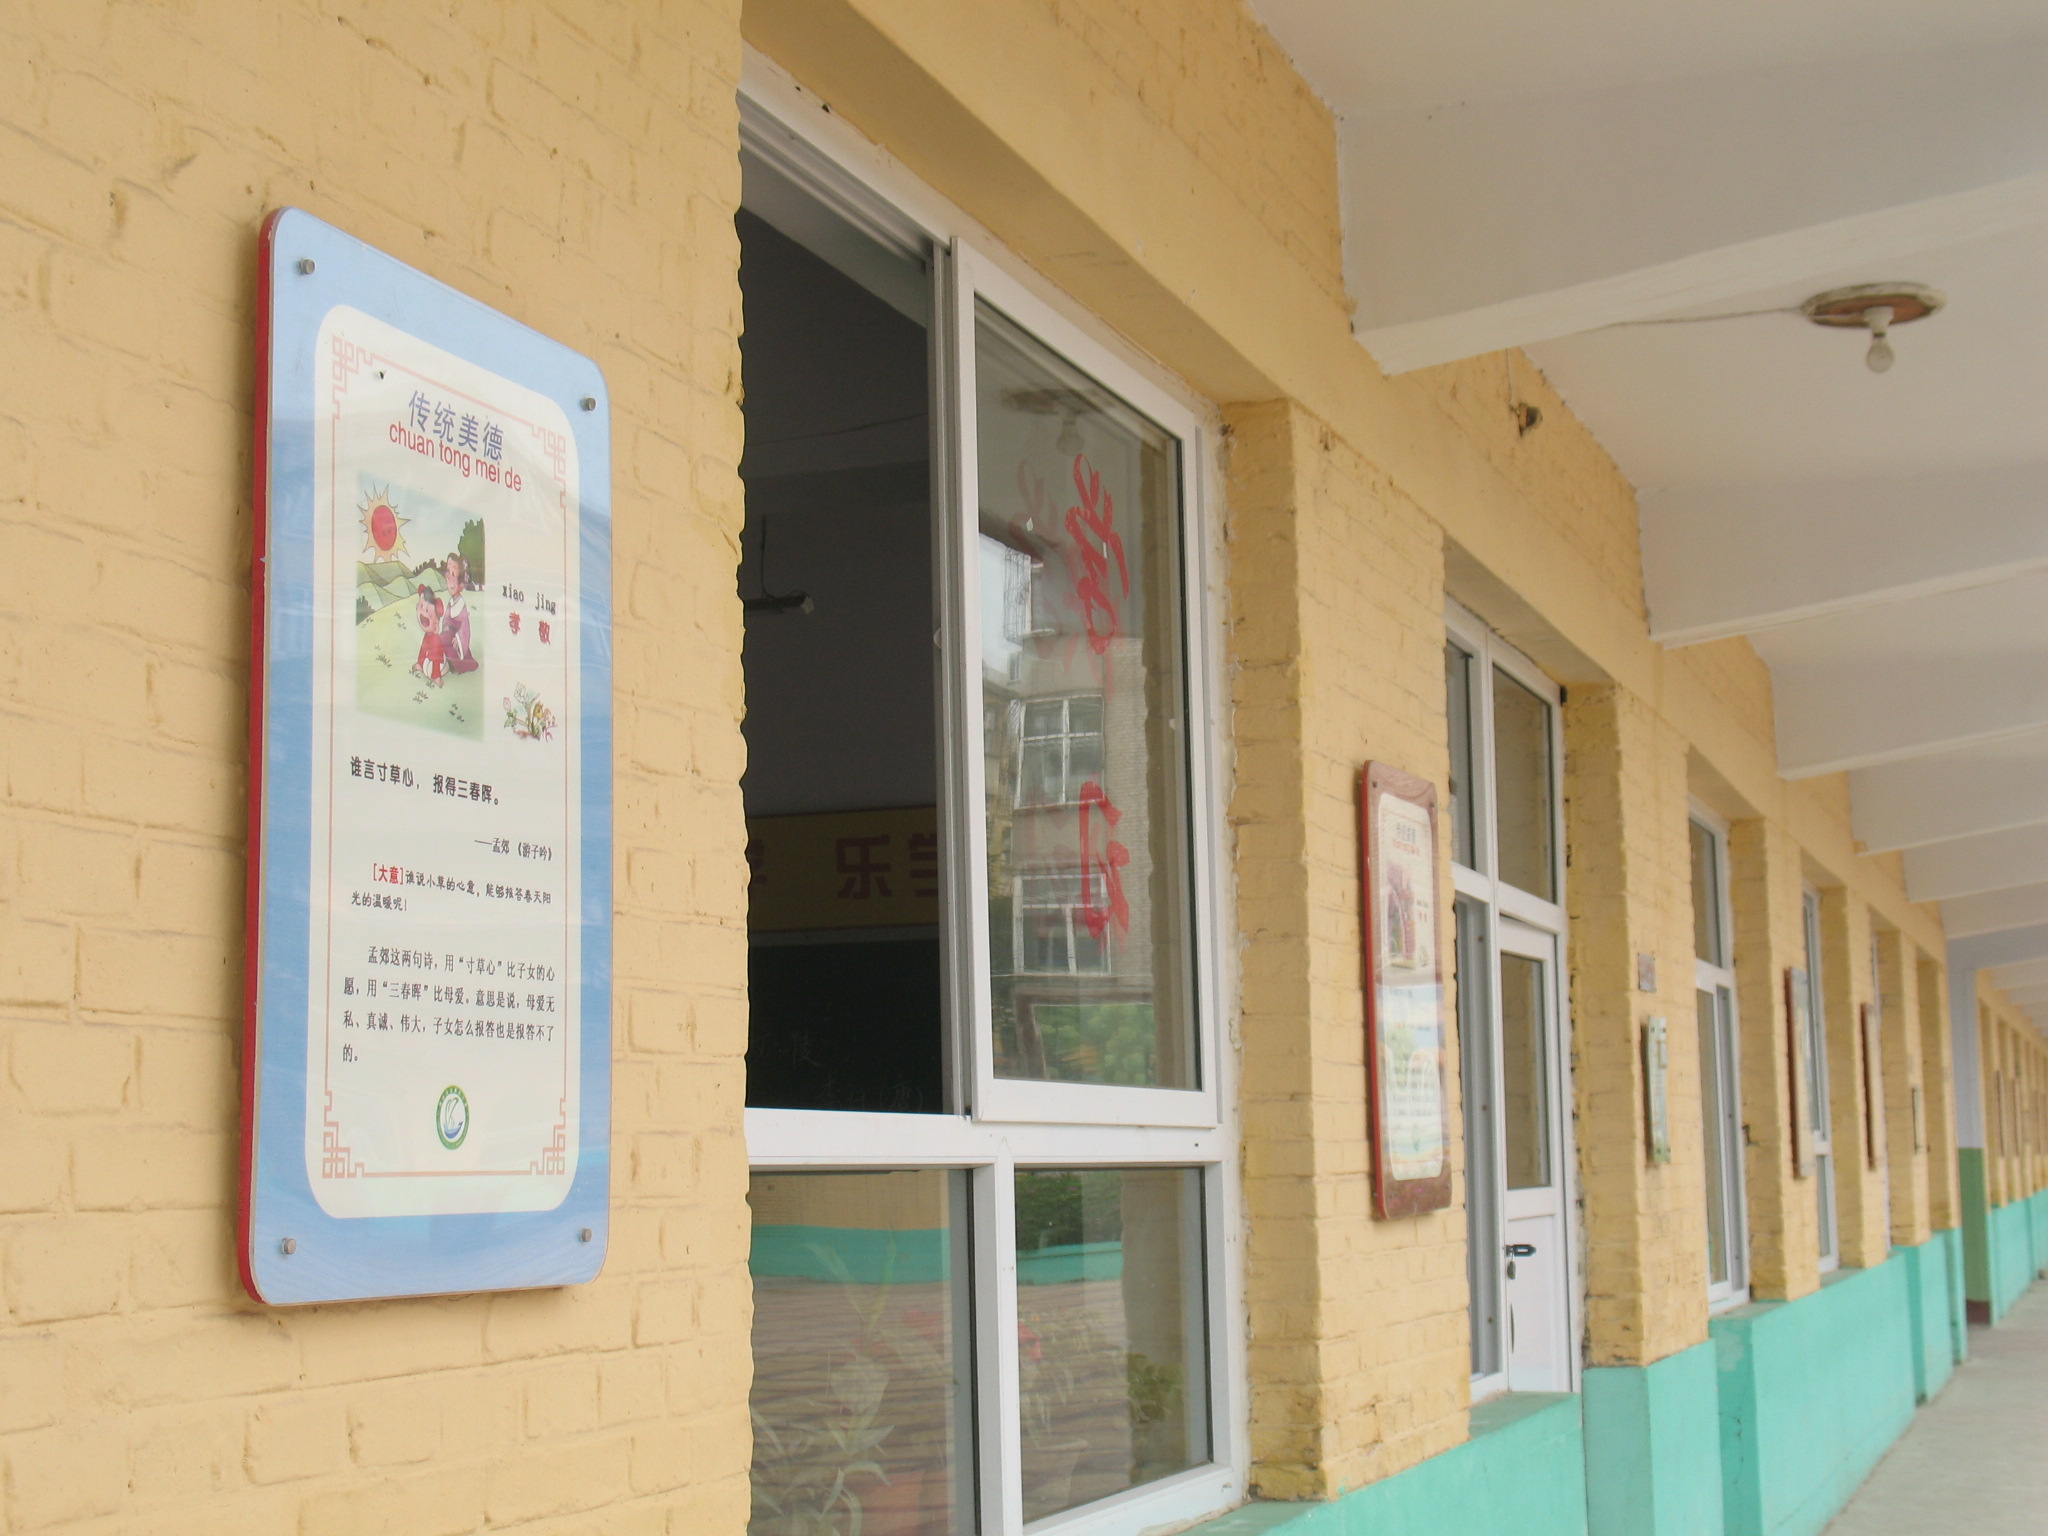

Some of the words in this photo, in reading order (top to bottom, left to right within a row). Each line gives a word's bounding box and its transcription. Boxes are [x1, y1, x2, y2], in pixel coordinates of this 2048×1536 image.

[408, 389, 503, 461] 传统美德
[389, 421, 434, 458] chuan
[439, 439, 471, 478] tong
[475, 459, 500, 484] mei
[504, 466, 522, 492] de
[502, 583, 524, 602] xiao
[535, 592, 556, 615] jing
[342, 1043, 359, 1063] 的。
